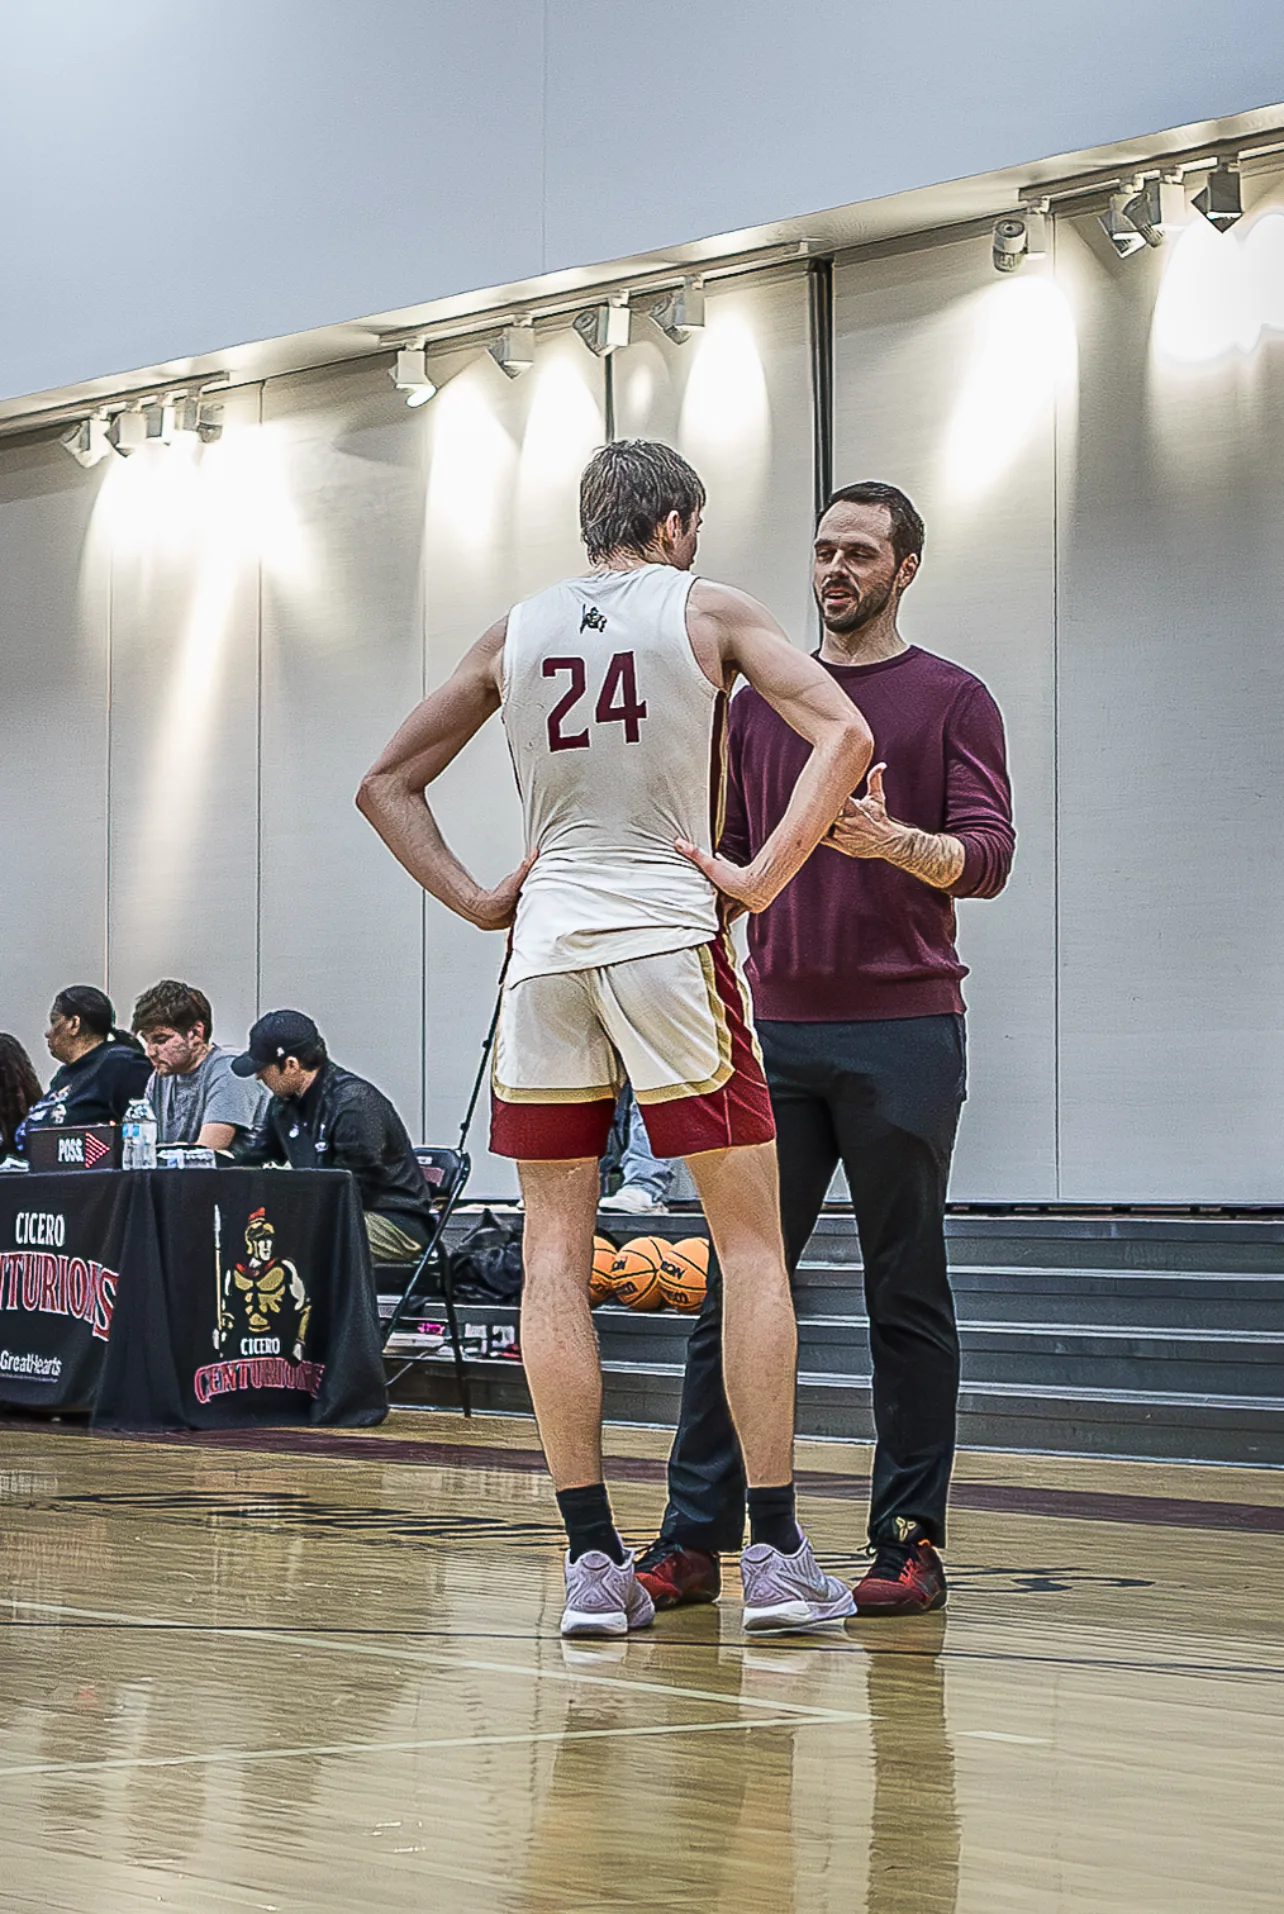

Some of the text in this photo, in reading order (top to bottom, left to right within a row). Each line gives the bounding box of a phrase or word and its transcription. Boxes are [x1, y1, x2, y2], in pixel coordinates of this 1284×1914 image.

[541, 650, 648, 753] 24
[15, 1212, 66, 1247] CICERO
[0, 1251, 120, 1341] TURIONS
[240, 1337, 281, 1355] CICERO
